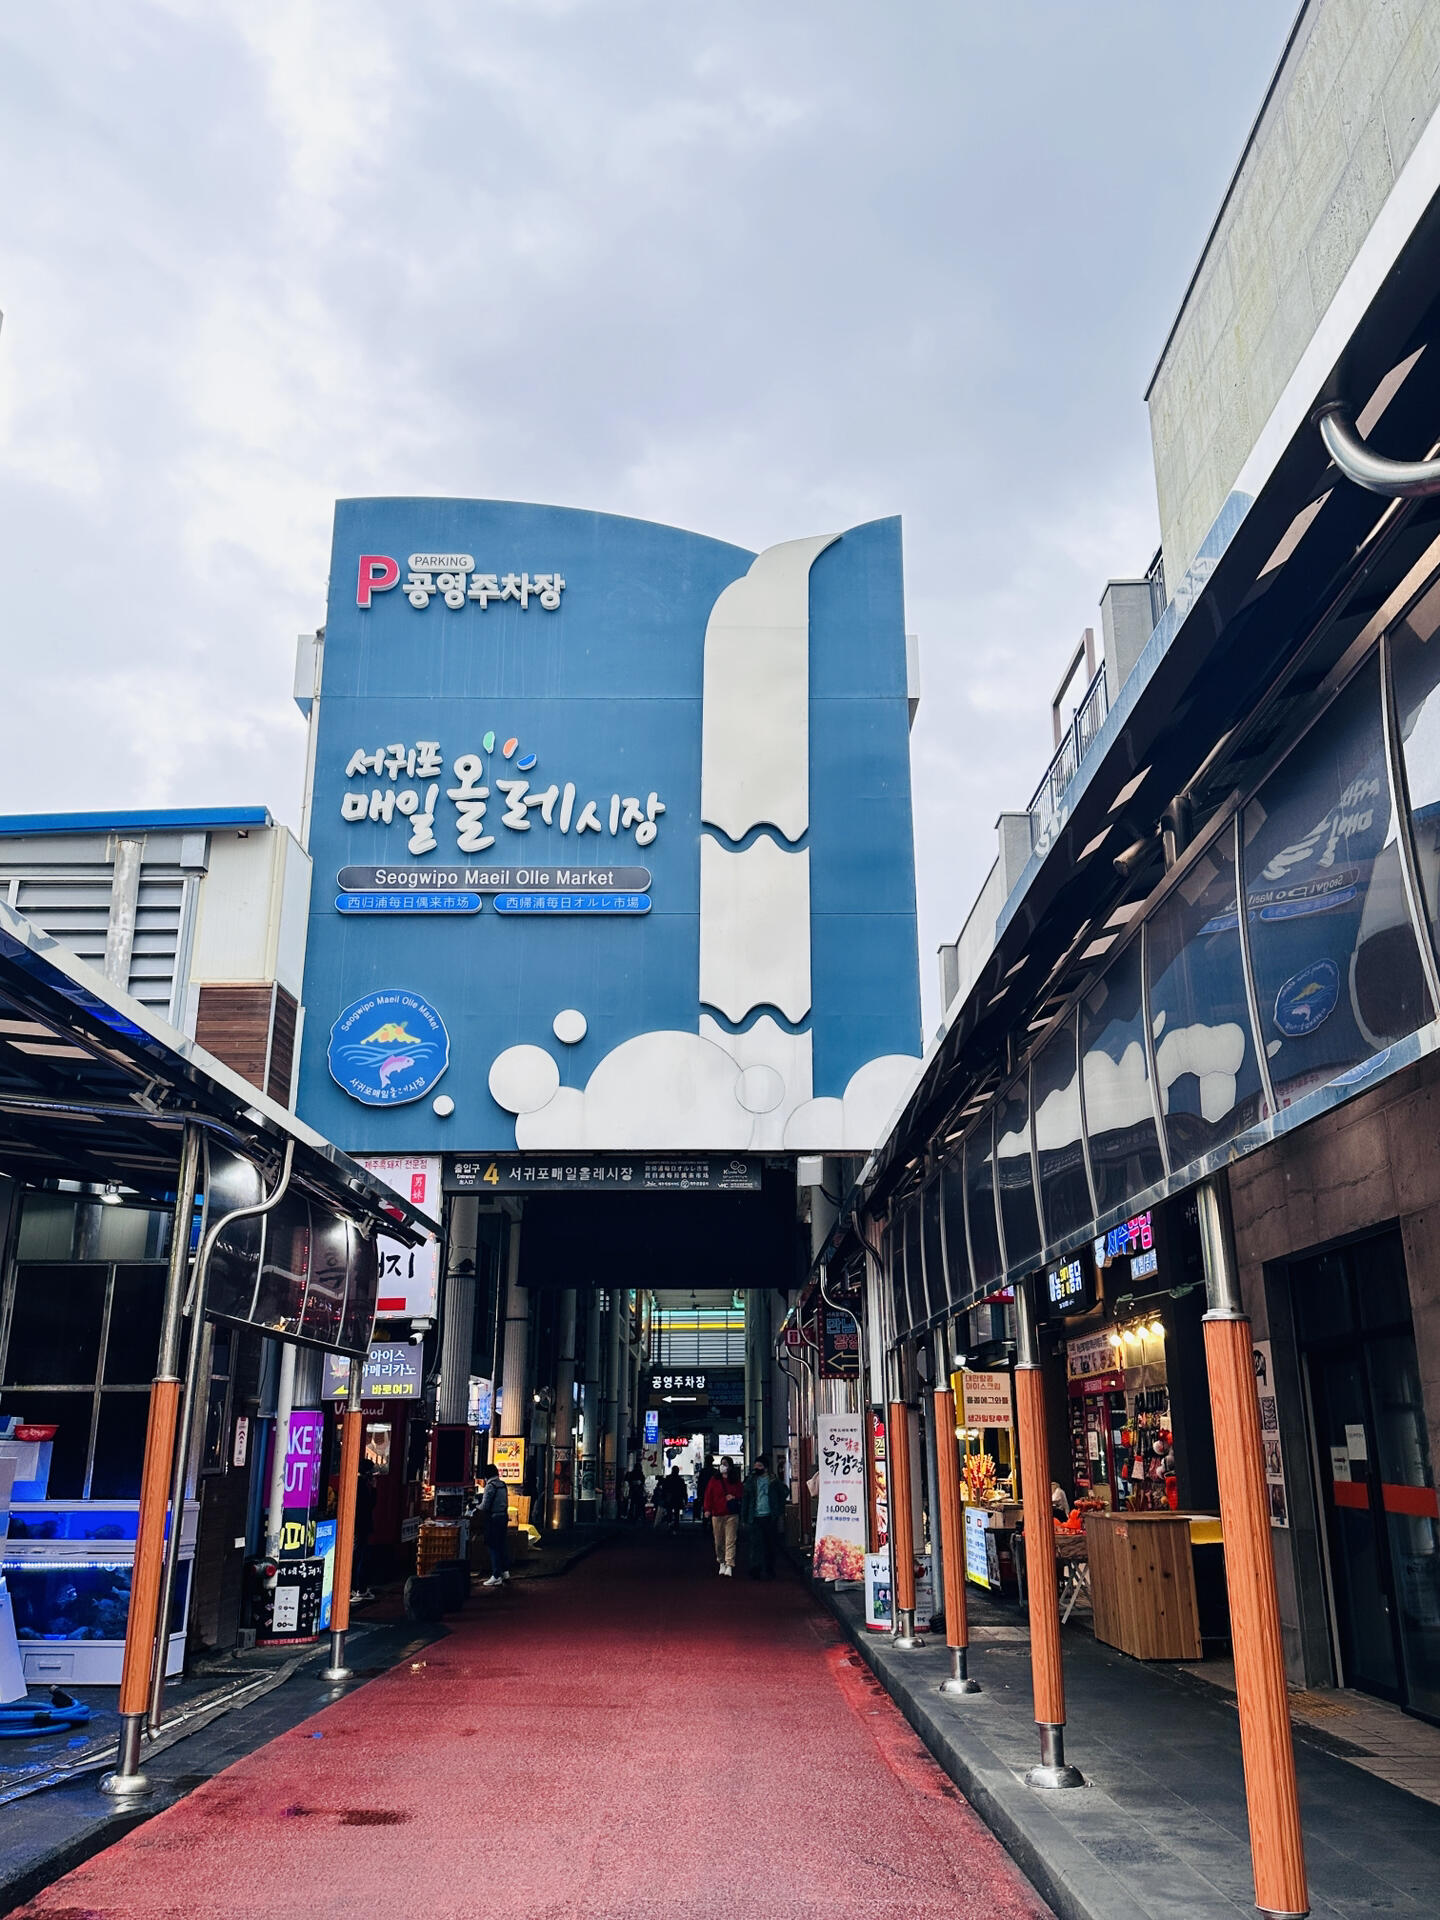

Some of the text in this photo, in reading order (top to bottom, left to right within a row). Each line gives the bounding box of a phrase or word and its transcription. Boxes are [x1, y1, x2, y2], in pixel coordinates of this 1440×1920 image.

[414, 556, 468, 568] PARKING
[356, 554, 400, 608] P
[402, 572, 566, 610] 공영주차장
[345, 741, 443, 781] 서귀포
[375, 869, 614, 889] Seogwipo Maeil Olle Market
[341, 995, 440, 1032] Seogwipo Maeil Olle Market
[454, 1163, 481, 1174] 출입구
[483, 1162, 499, 1185] 4
[509, 1166, 633, 1182] 서귀포매일올레시장
[370, 1349, 406, 1362] 아이스
[371, 1383, 413, 1395] 바로여기
[652, 1375, 706, 1389] 공영주차장
